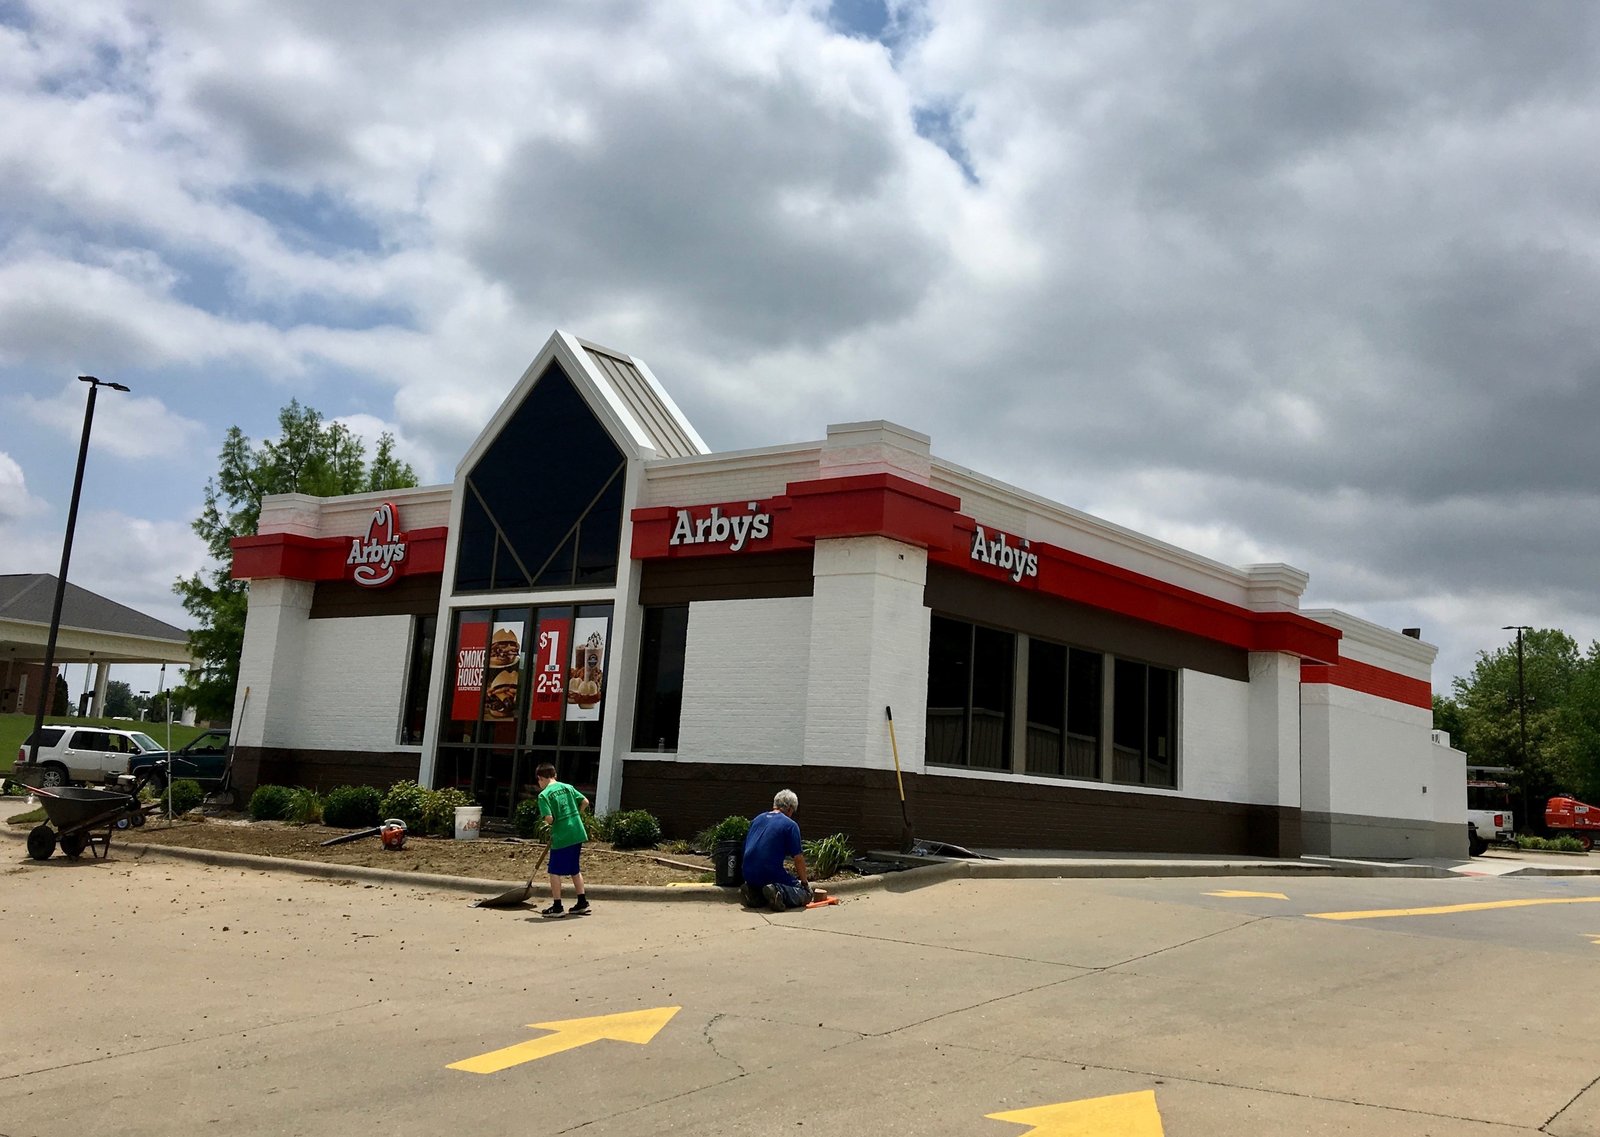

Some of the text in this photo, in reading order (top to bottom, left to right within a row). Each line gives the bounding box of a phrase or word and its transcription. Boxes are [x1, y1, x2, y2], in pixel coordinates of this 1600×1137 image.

[669, 502, 770, 551] Arby's
[346, 534, 406, 569] Arby's
[971, 525, 1038, 583] Arby's
[458, 649, 486, 668] SMOKE
[539, 631, 560, 672] $1
[457, 668, 484, 687] HOUSE
